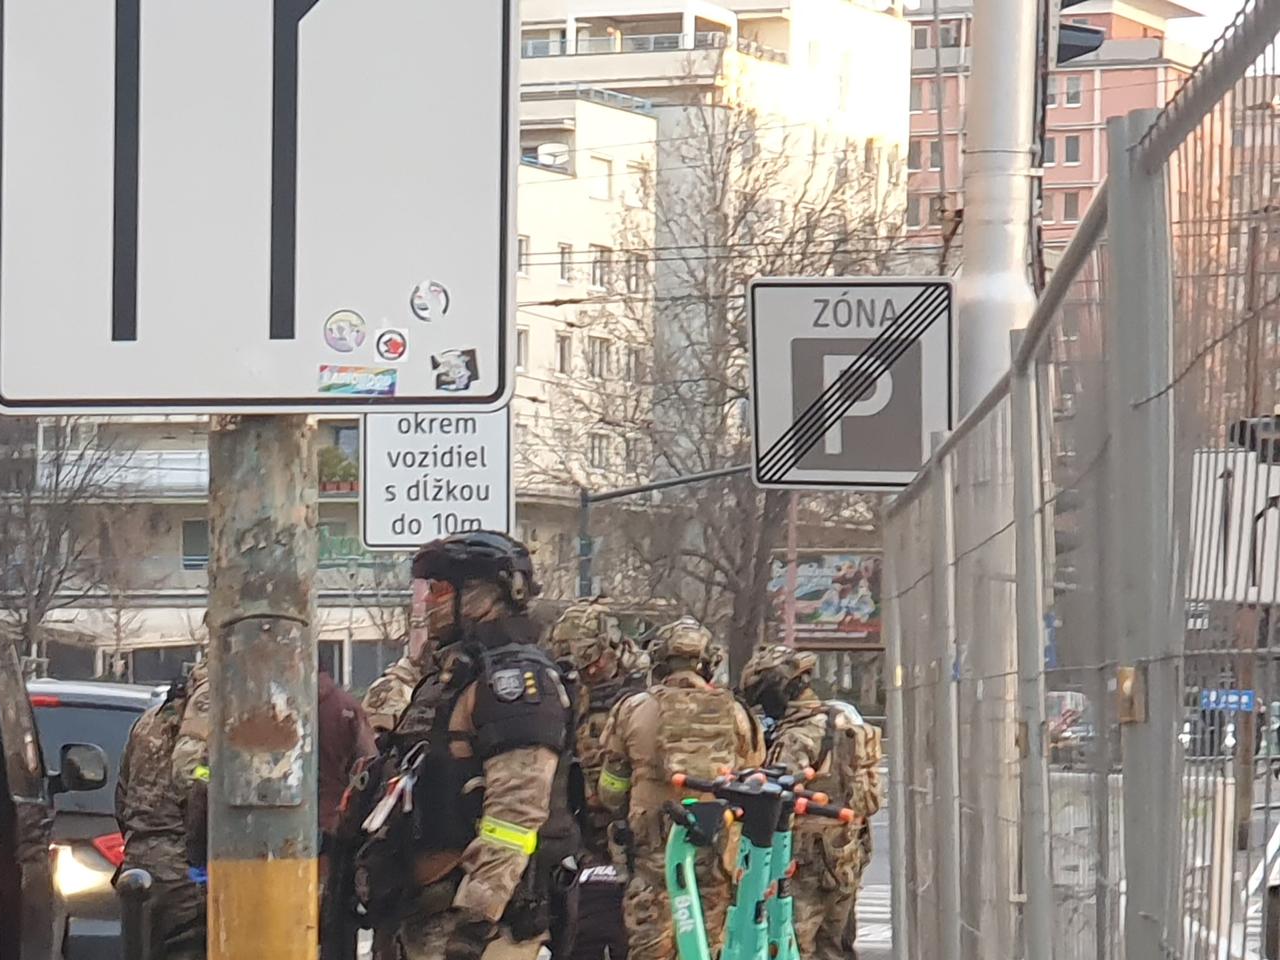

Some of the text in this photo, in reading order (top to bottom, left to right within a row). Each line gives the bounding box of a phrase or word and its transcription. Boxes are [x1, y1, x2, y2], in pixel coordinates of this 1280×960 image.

[812, 291, 900, 328] ZÓNA
[823, 355, 893, 454] P
[397, 413, 477, 434] okrem
[387, 444, 487, 468] vozidiel
[384, 473, 490, 502] s dĺžkou
[392, 513, 483, 535] do 10m
